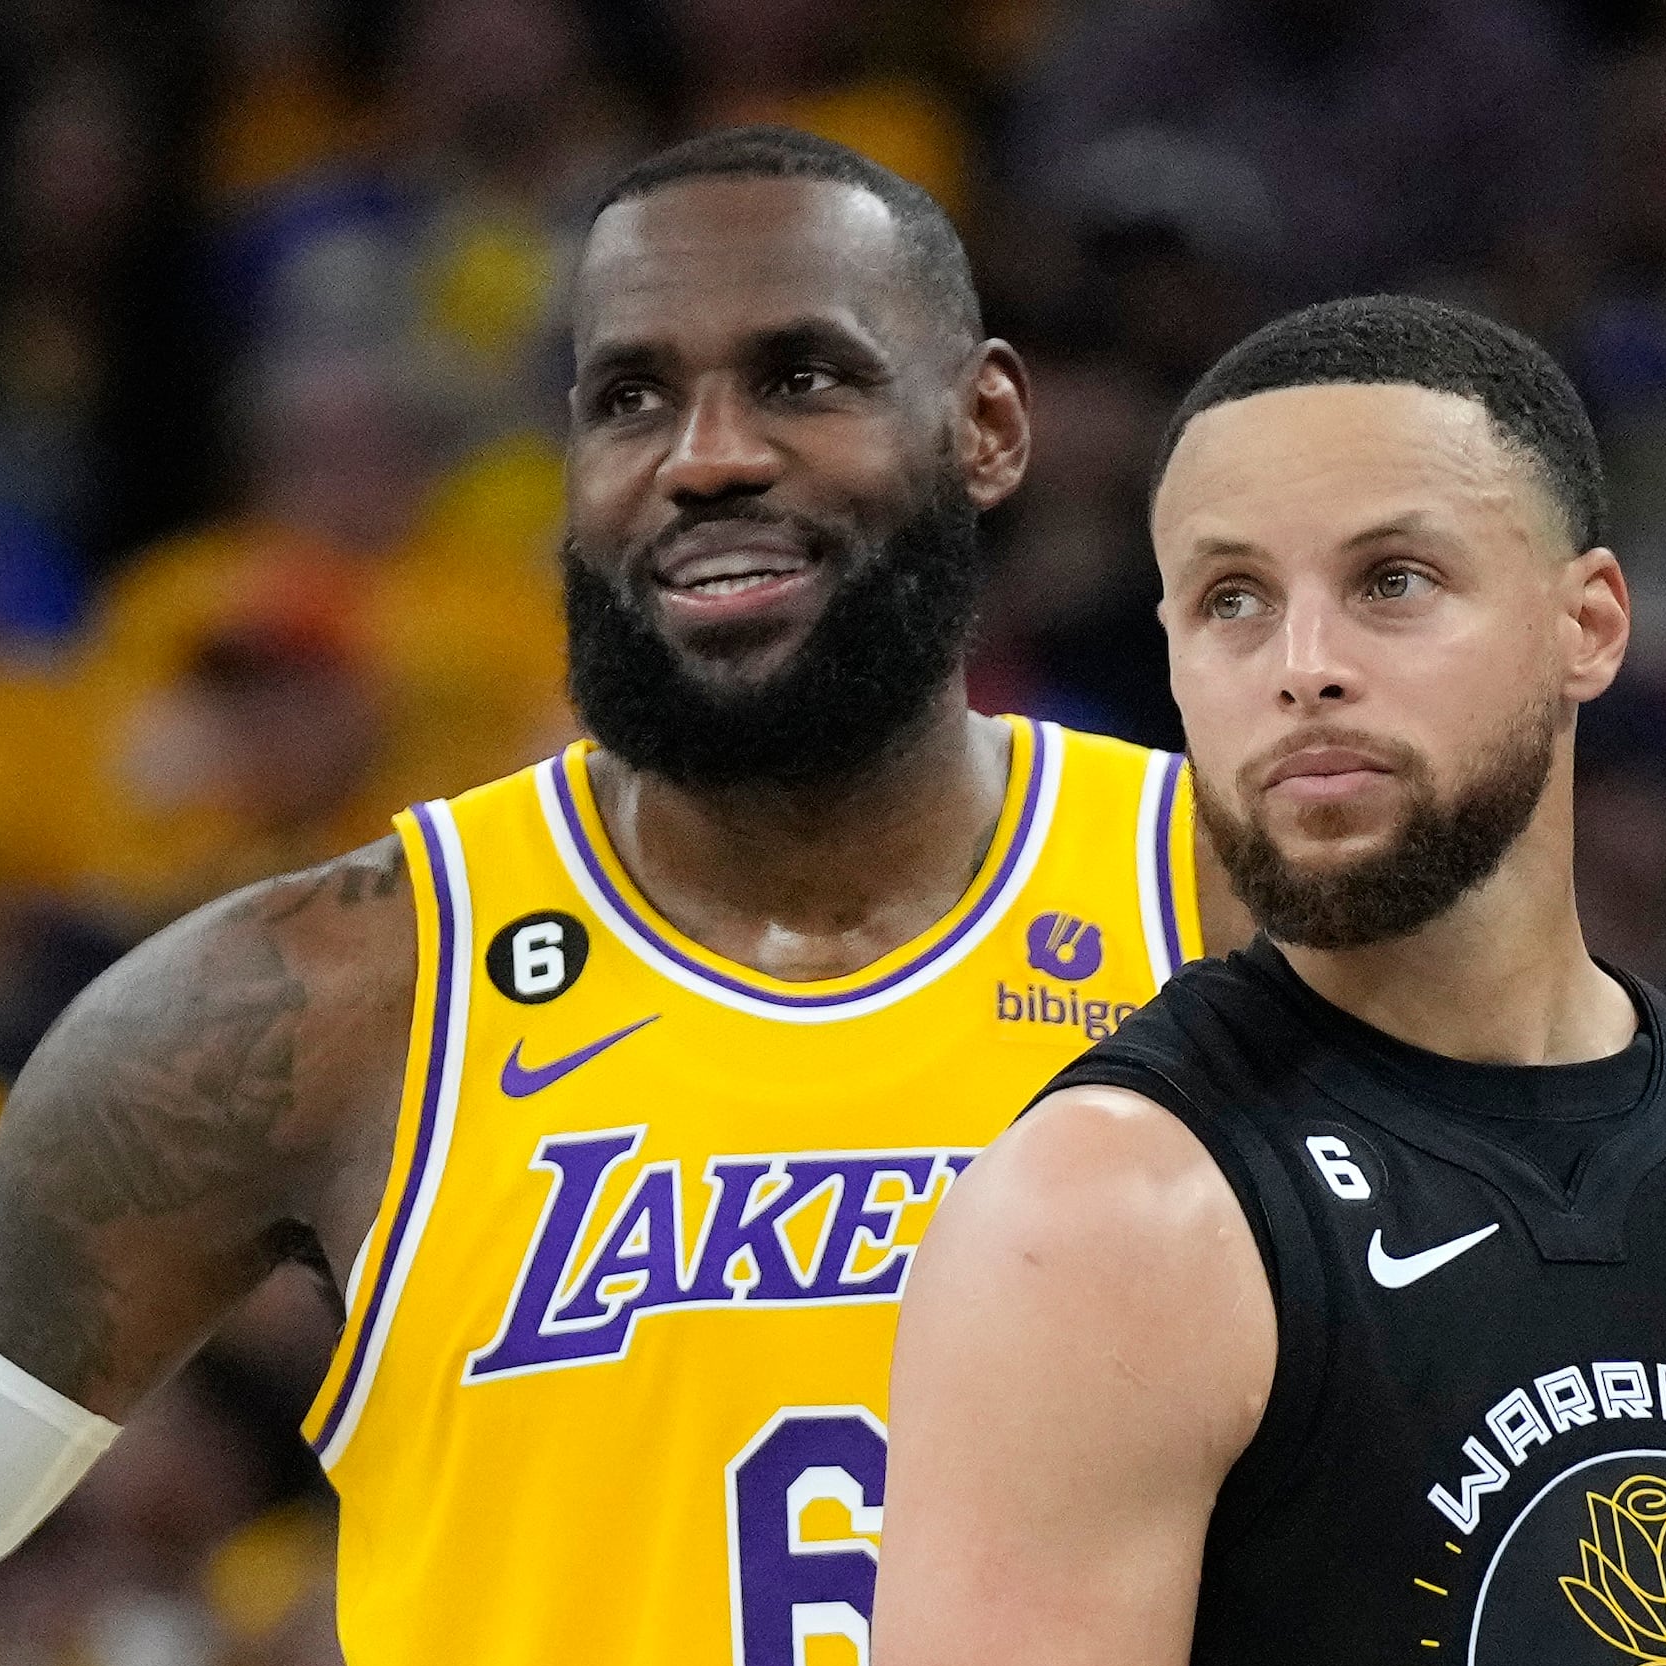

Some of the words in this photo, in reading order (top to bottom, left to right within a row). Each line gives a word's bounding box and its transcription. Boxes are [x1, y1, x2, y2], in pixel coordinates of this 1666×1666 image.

[512, 920, 566, 995] 6
[1304, 1134, 1372, 1200] 6
[460, 1122, 987, 1386] LAKE
